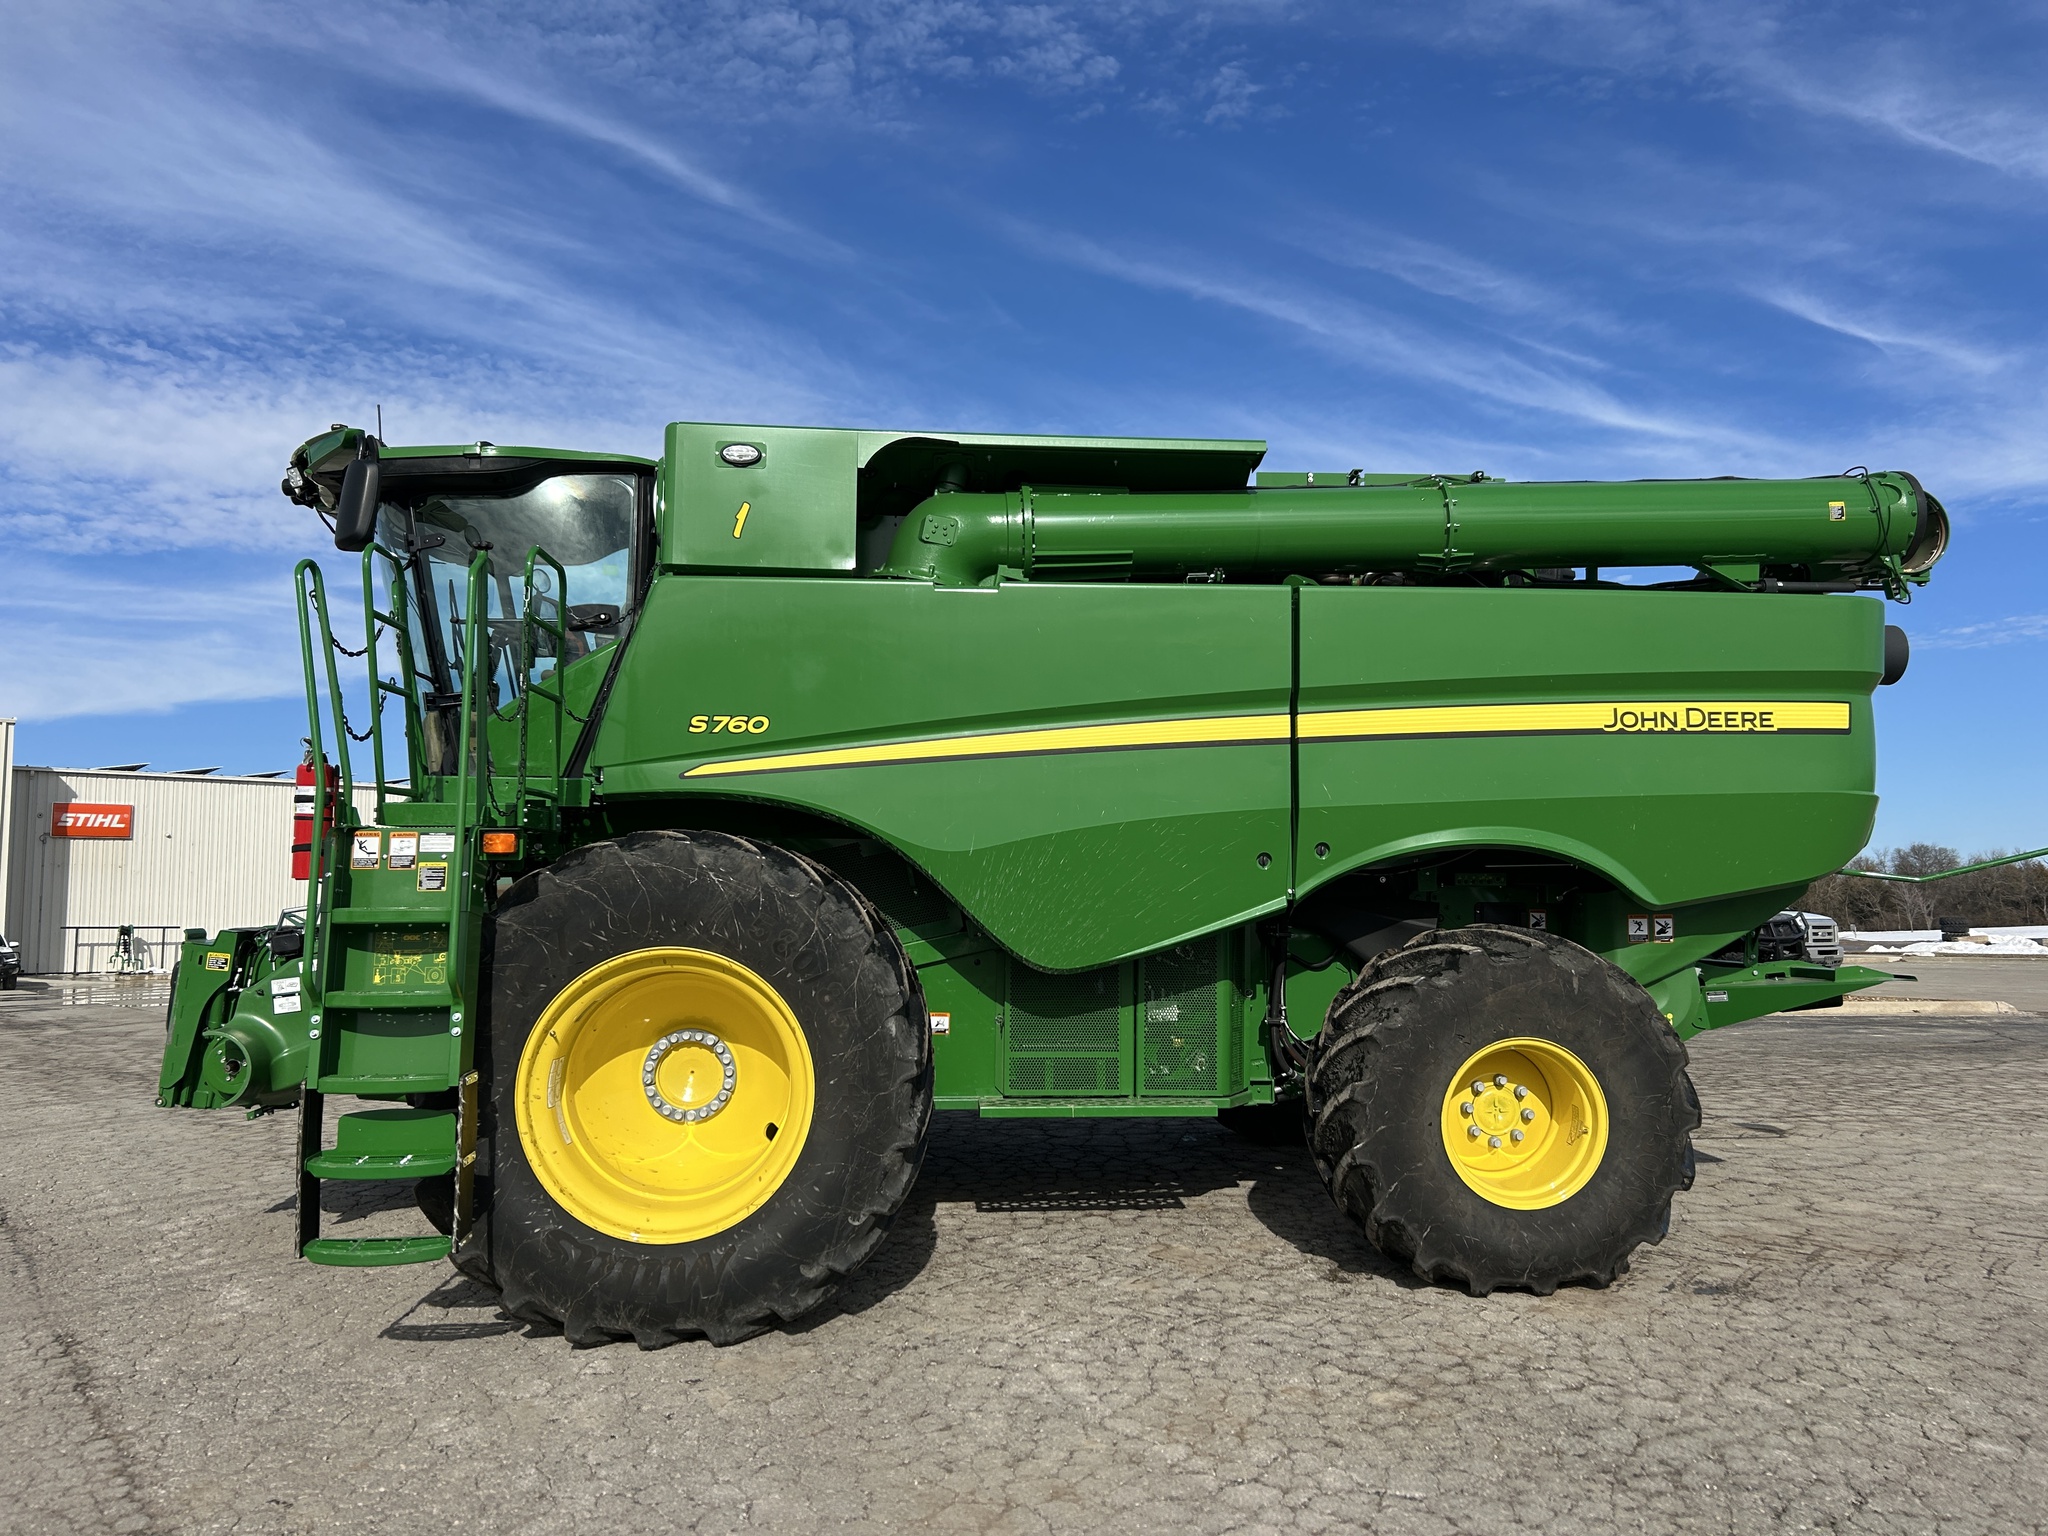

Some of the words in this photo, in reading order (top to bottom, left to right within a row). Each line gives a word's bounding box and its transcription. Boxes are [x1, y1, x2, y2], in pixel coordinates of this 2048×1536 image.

[732, 501, 751, 539] 1
[687, 714, 771, 735] S760
[1603, 707, 1678, 729] JOHN
[1685, 707, 1775, 729] DEERE
[57, 813, 126, 828] STIHL
